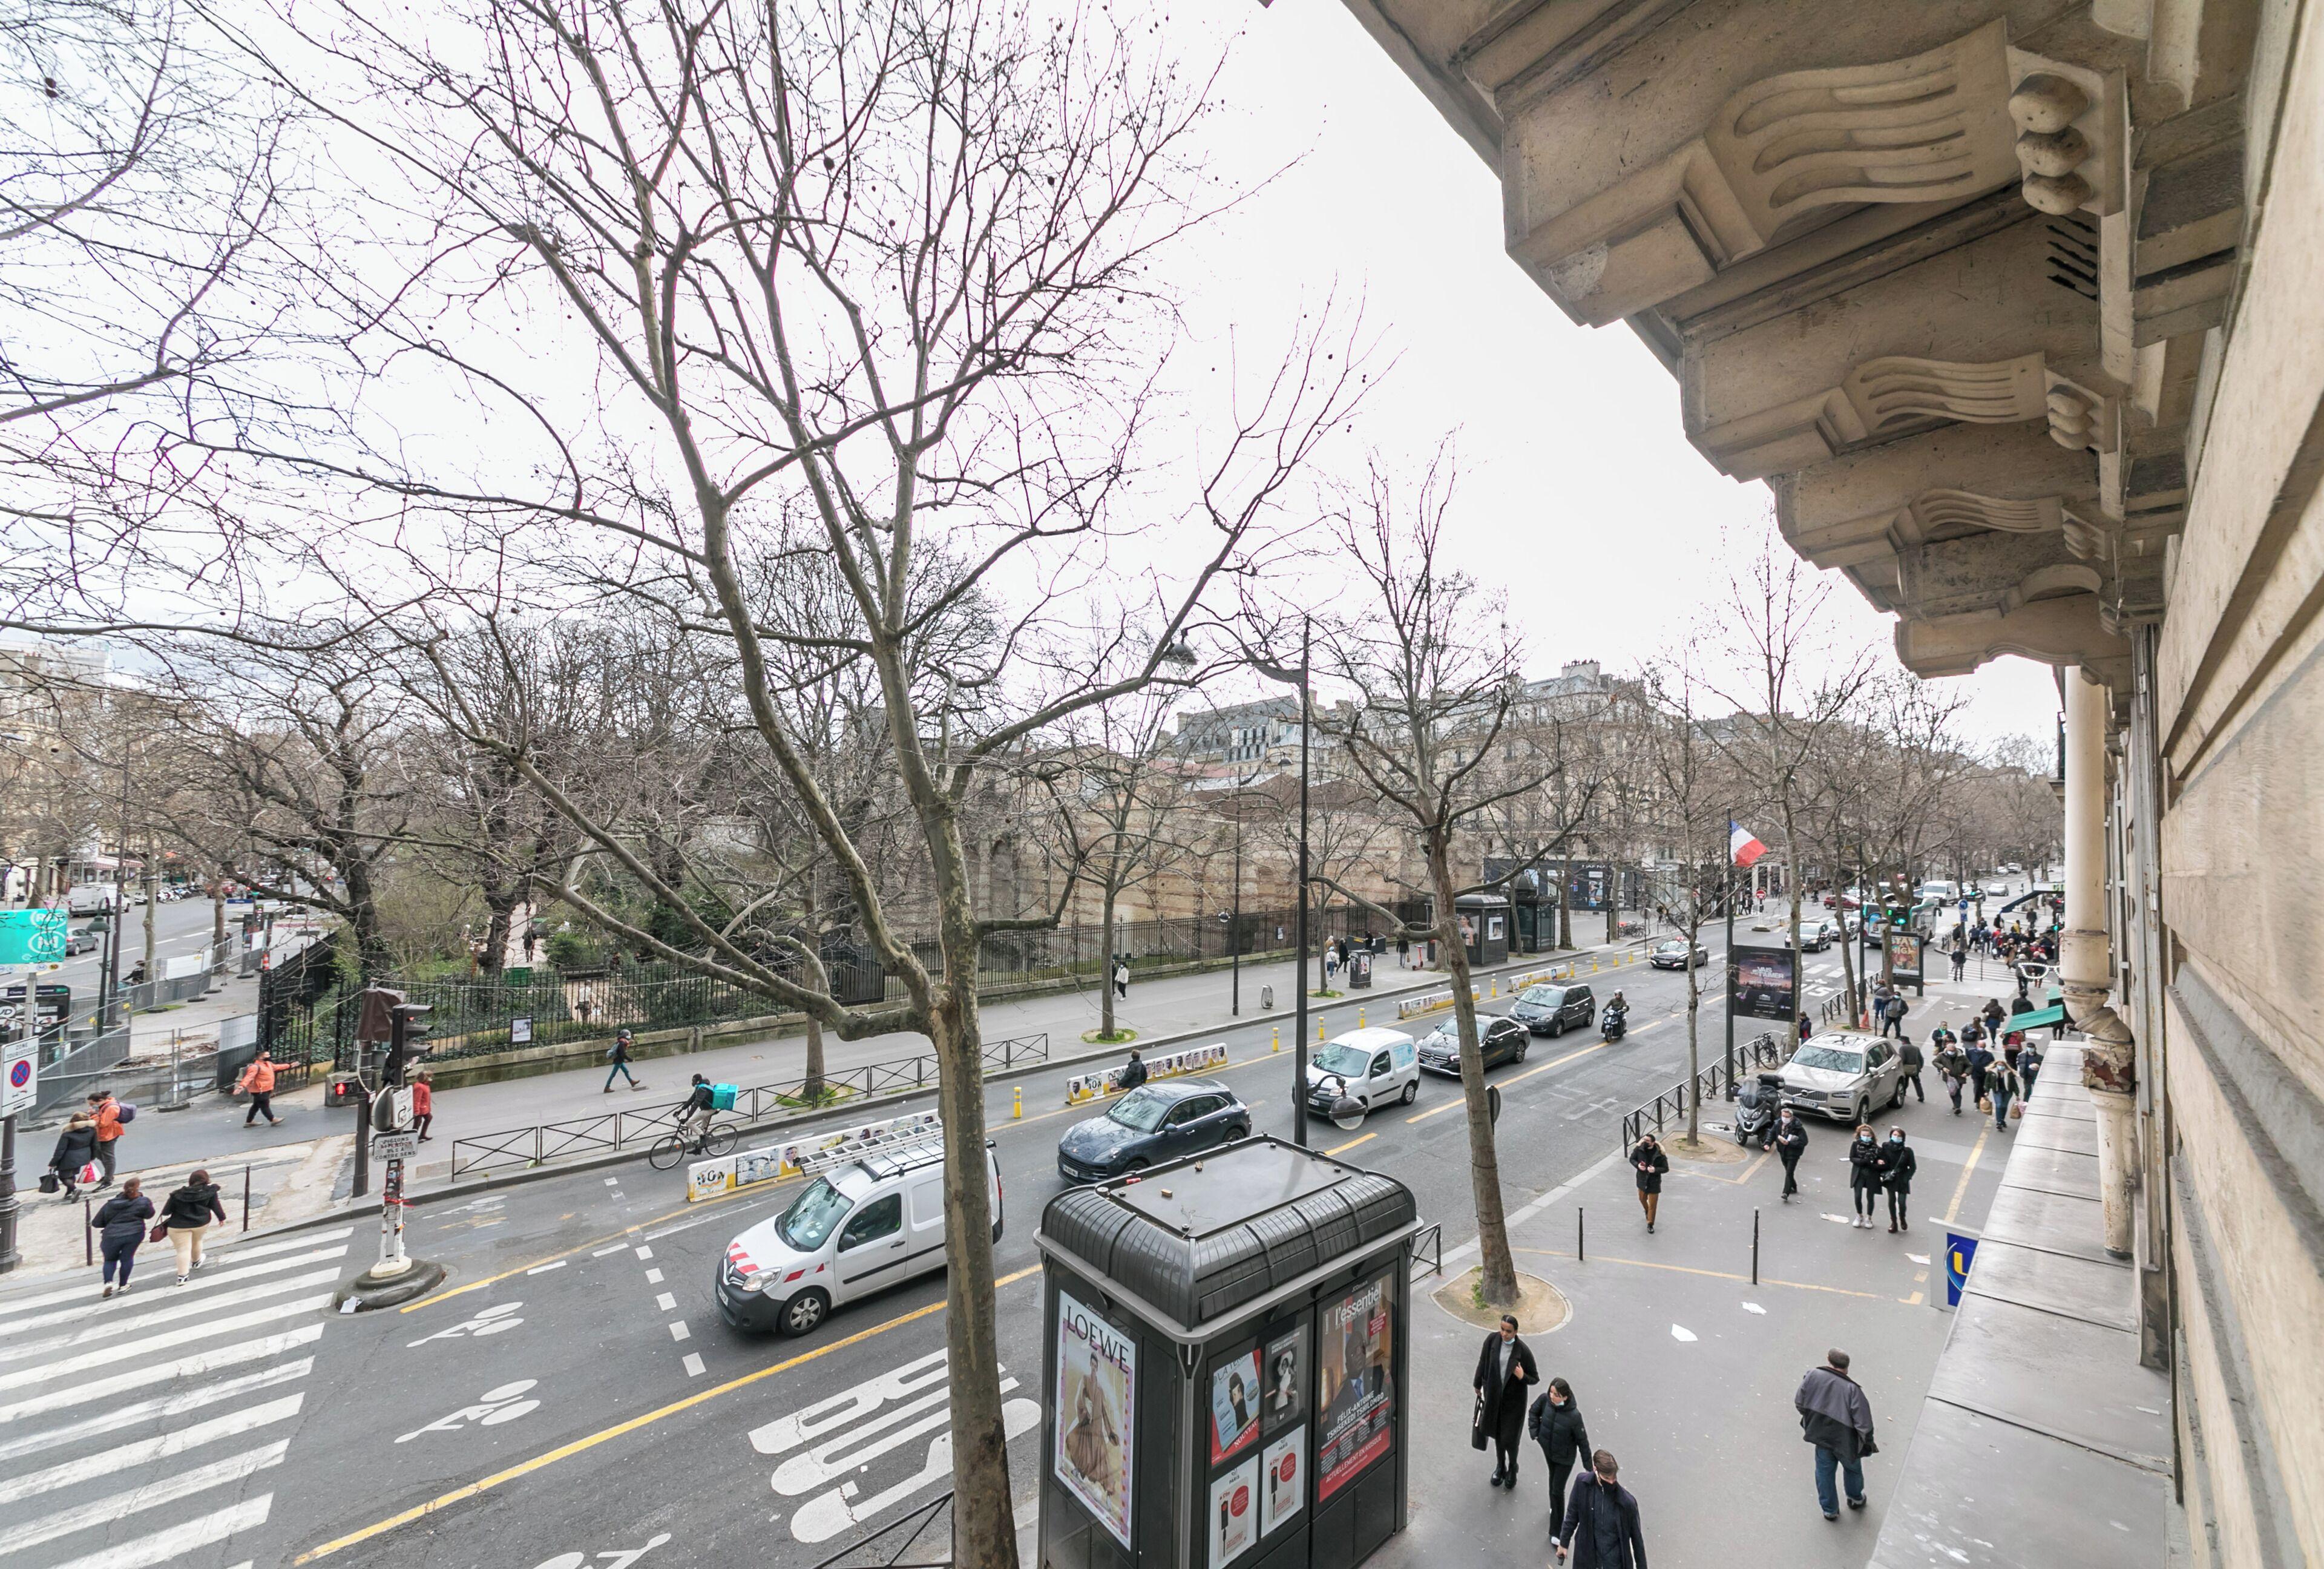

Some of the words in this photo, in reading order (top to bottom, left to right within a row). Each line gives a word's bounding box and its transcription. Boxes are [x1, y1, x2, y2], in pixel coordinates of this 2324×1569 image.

[1336, 1283, 1382, 1326] l'essentiel
[1067, 1304, 1129, 1375] LOEWE
[1327, 1412, 1356, 1441] TSHISEKEDI
[1356, 1392, 1384, 1418] TSHILOMBO
[1337, 1390, 1374, 1424] FÉLIX-ANTOINE
[747, 1347, 1043, 1544] BUS
[1326, 1453, 1359, 1484] ACTUELLEMENT
